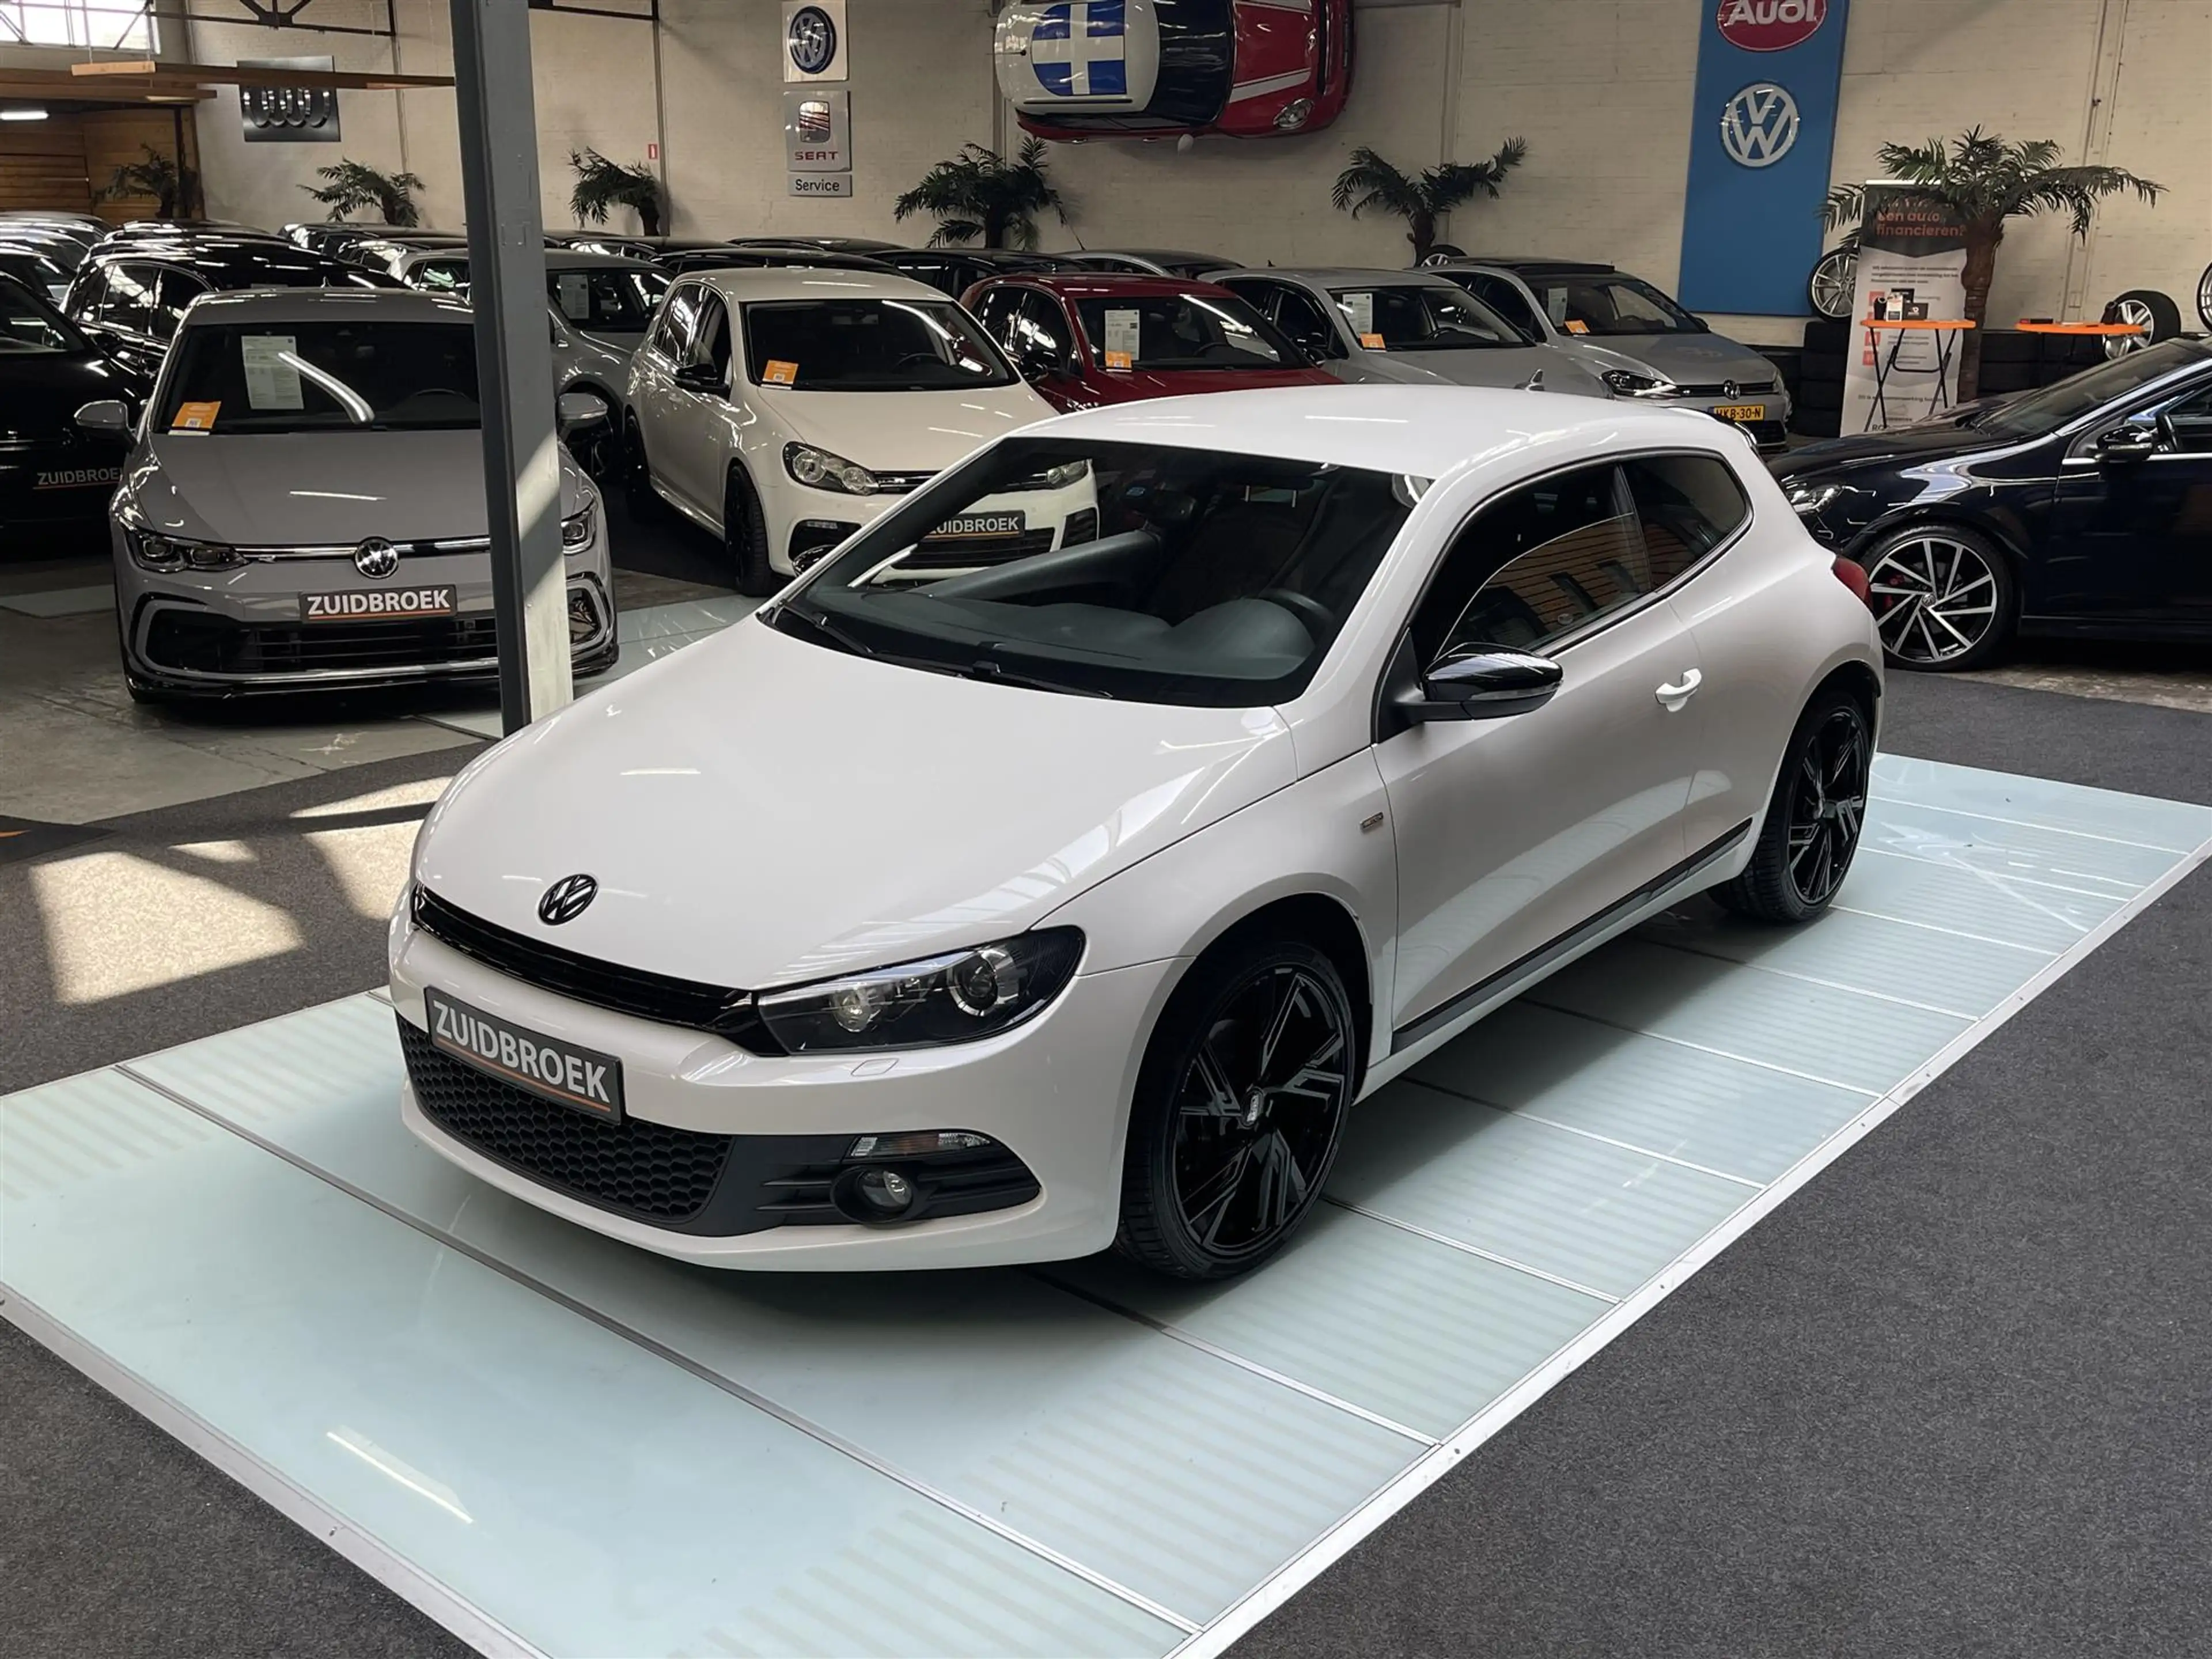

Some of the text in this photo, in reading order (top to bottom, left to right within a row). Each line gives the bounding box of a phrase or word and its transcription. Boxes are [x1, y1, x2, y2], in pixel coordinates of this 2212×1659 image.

[794, 151, 838, 161] SEAT
[795, 179, 840, 192] Service
[1876, 224, 1967, 236] financieren?
[37, 467, 123, 485] ZUIDBROE
[929, 517, 1018, 535] UIDBROEK
[307, 589, 450, 615] ZUIDBROEK
[433, 1000, 610, 1103] ZUIDBROEK
